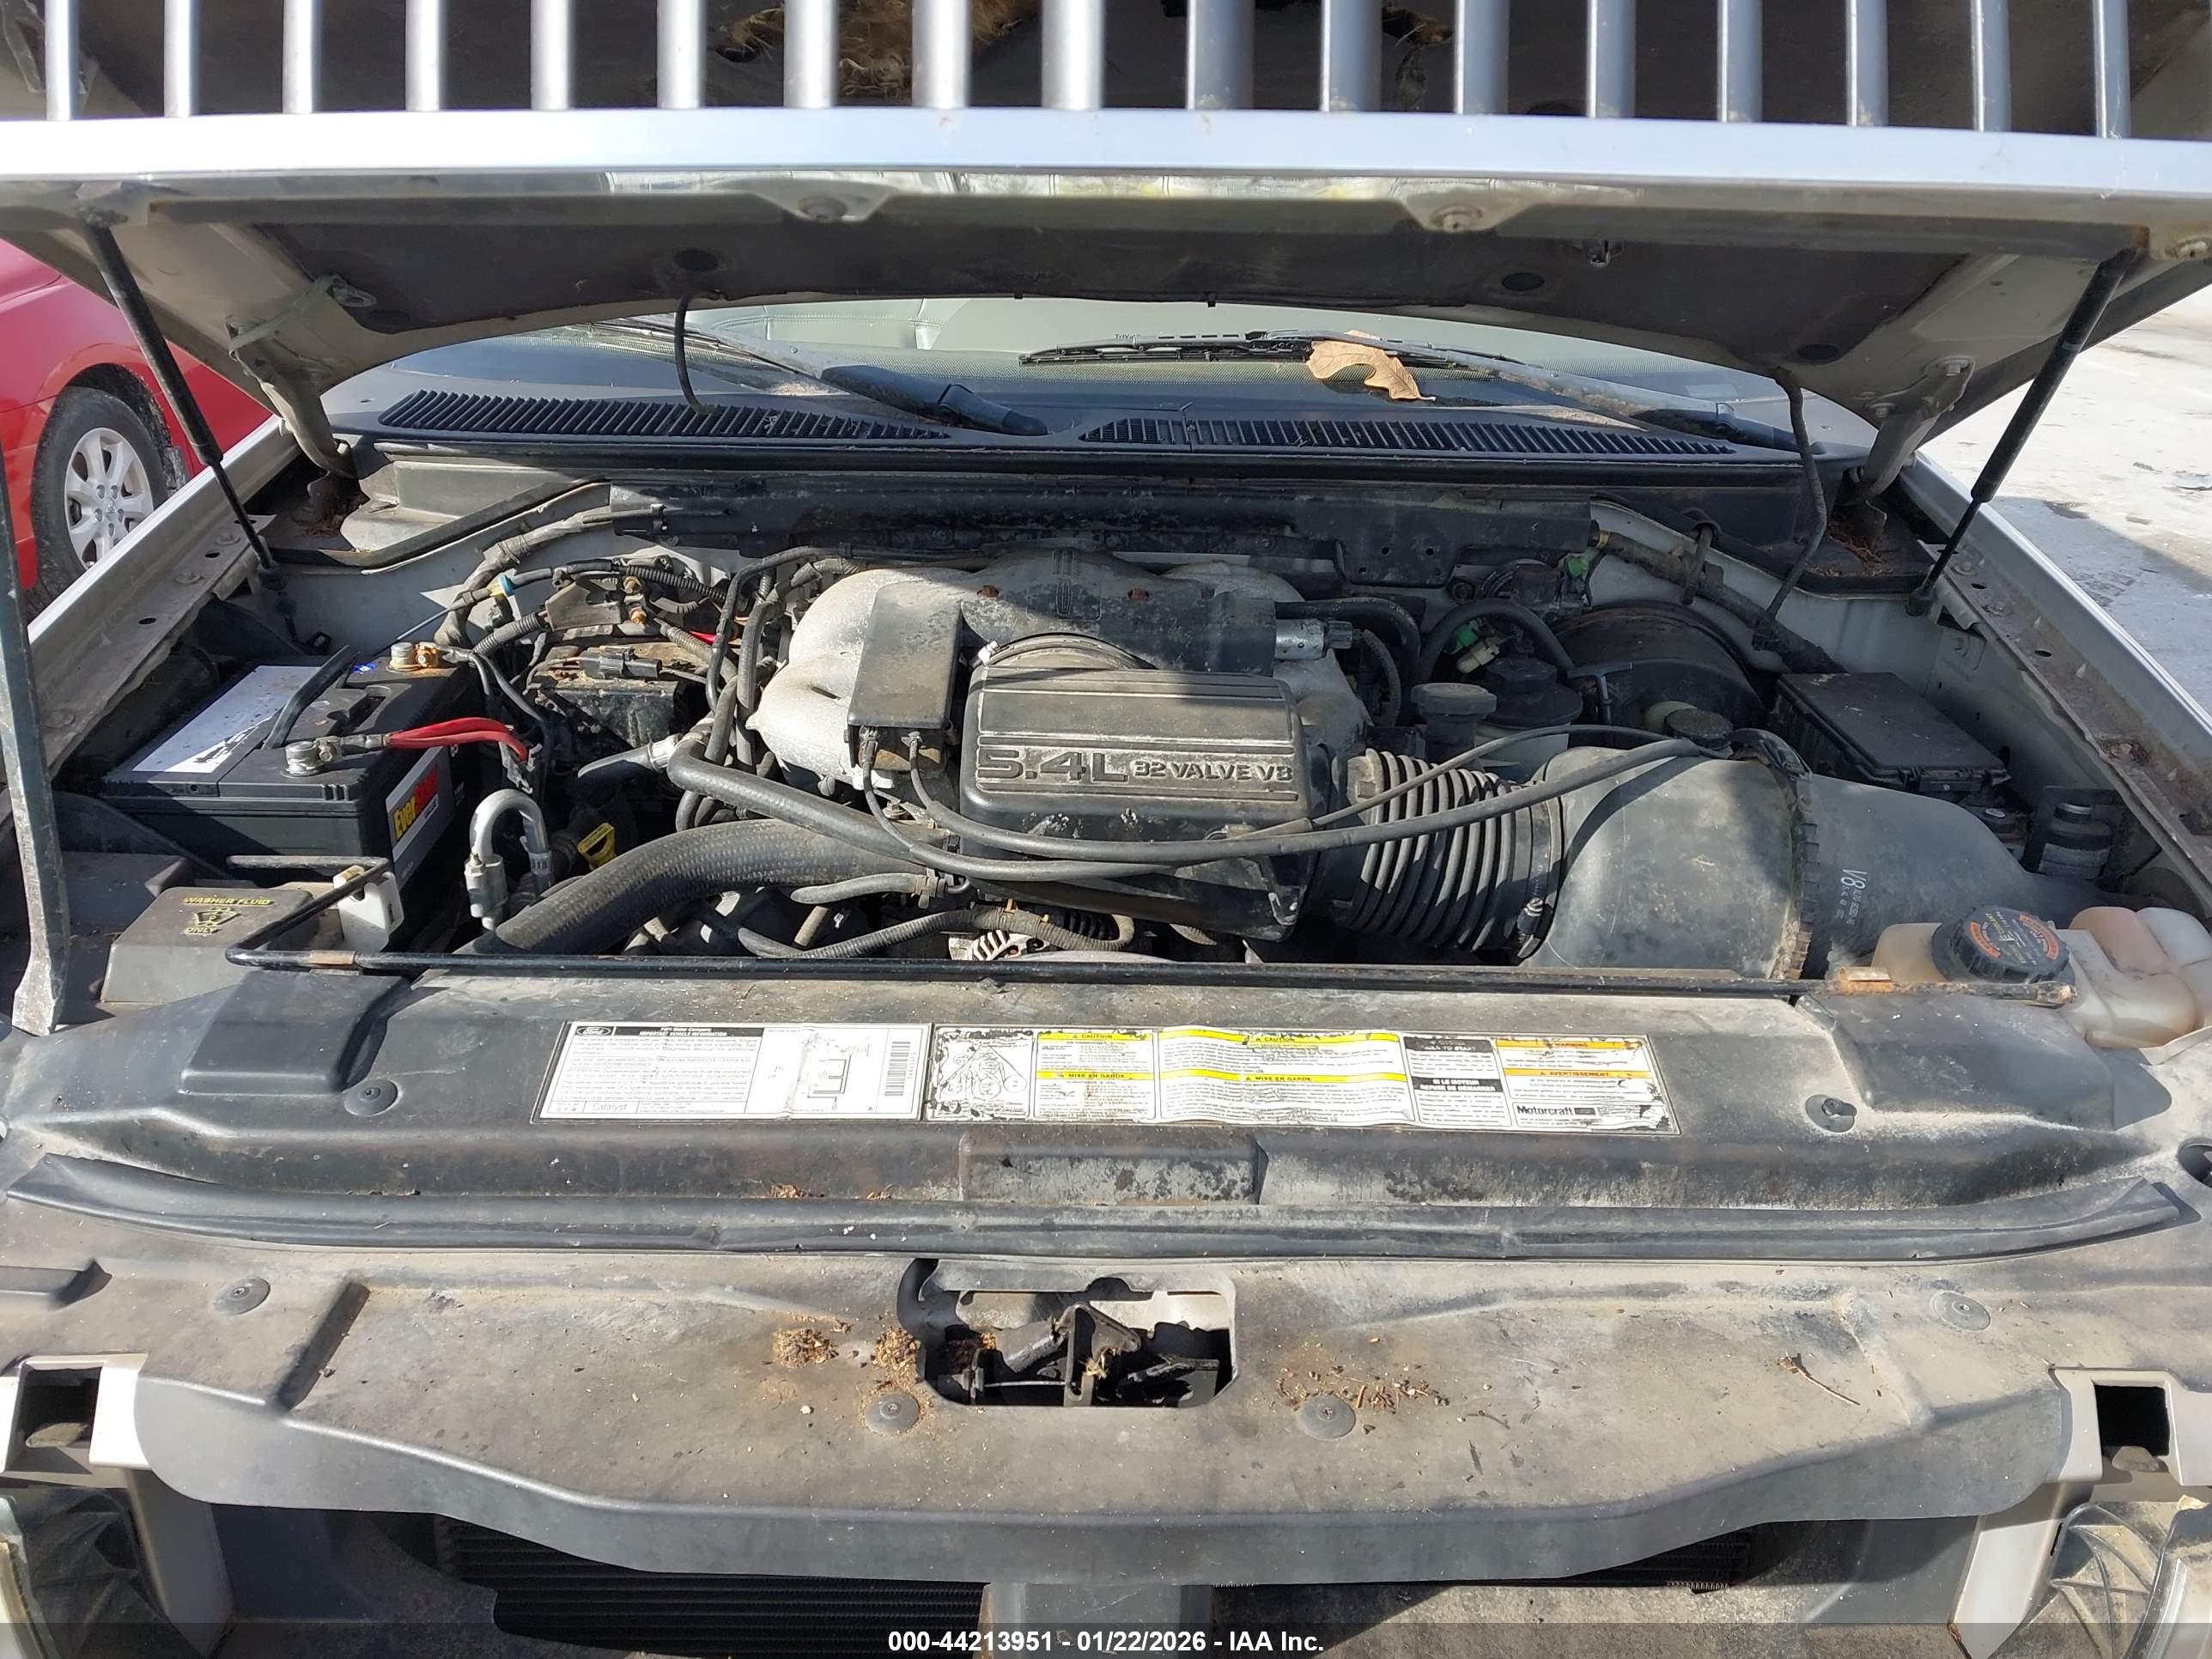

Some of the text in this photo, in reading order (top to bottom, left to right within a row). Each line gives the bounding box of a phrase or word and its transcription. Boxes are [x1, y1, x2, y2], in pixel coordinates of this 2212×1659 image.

[977, 749, 1294, 782] 5.4L 32 VALVE V8
[1840, 868, 1869, 889] V8
[183, 896, 273, 906] WASHER FLUID
[592, 1102, 629, 1113] Catalyst
[1516, 1105, 1574, 1116] Motorcraft
